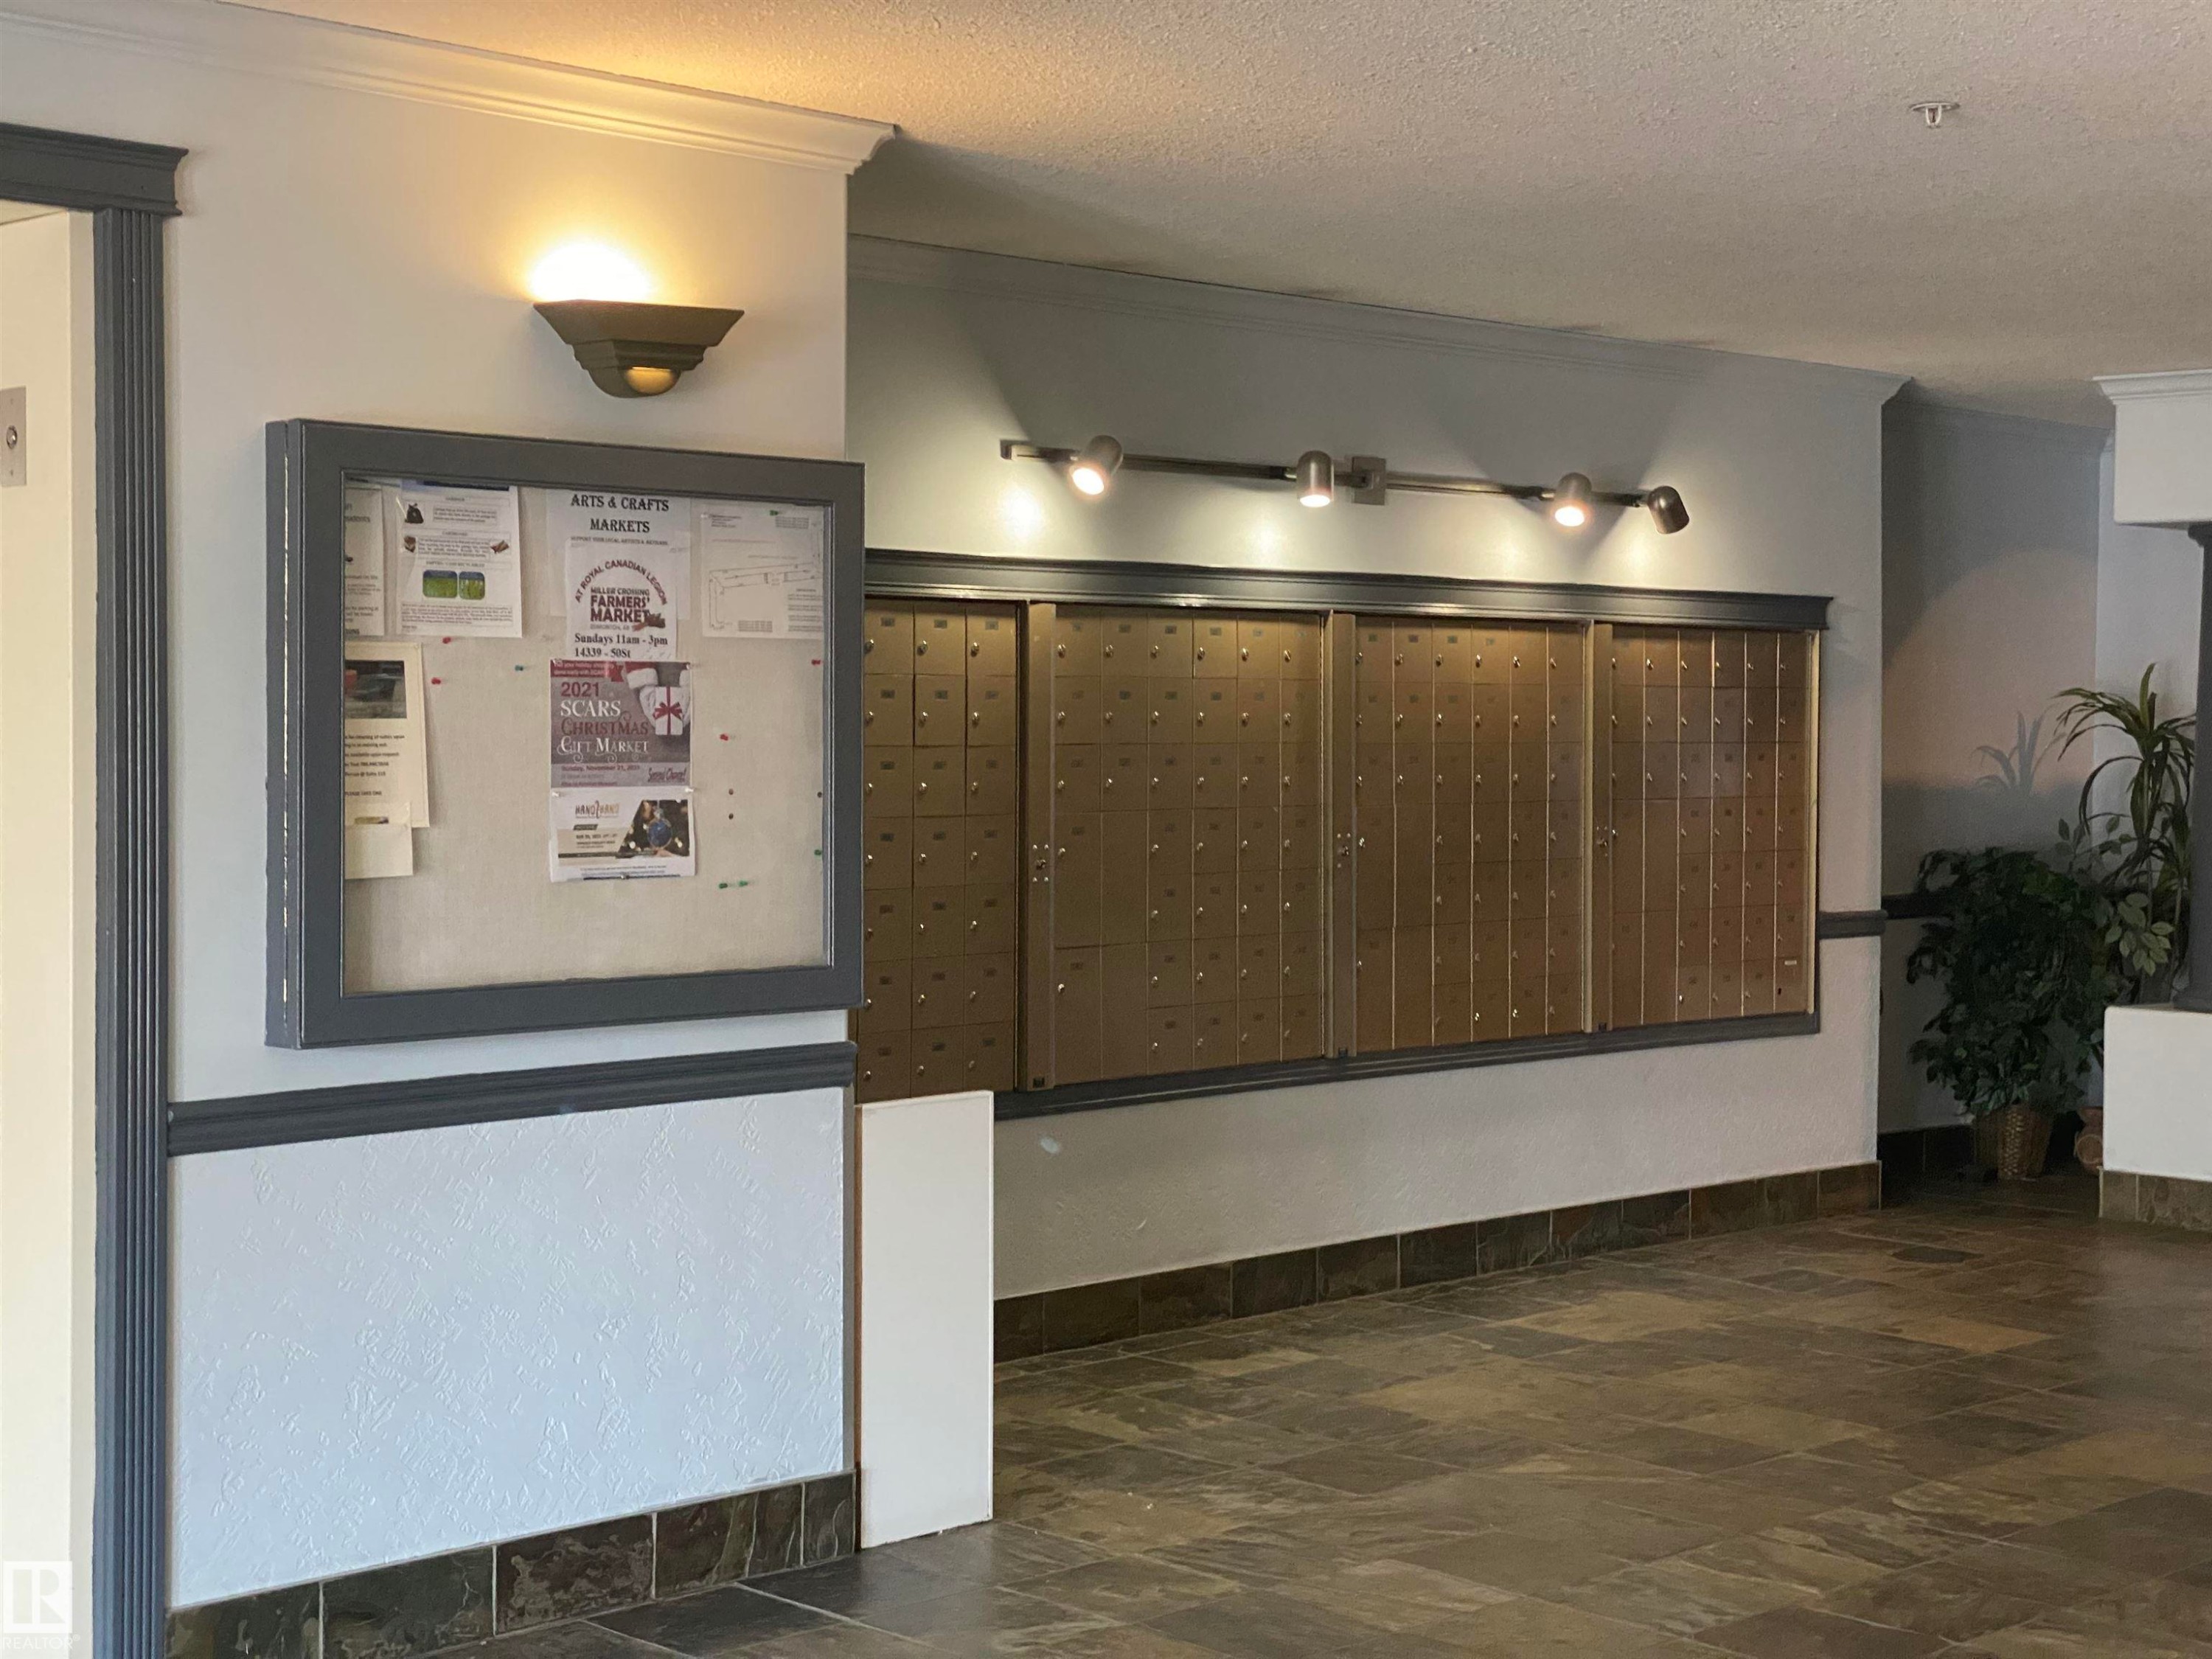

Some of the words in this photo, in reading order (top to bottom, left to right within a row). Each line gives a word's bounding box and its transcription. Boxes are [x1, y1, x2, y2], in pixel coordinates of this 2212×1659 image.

[571, 494, 605, 508] ARTS
[608, 495, 616, 509] &
[621, 497, 669, 512] CRAFTS
[590, 518, 650, 533] MARKETS
[575, 590, 583, 603] AT
[580, 566, 604, 590] ROYAL
[605, 560, 647, 576] CANADIAN
[646, 572, 667, 605] LEGION
[618, 588, 650, 596] CROSSING
[591, 595, 650, 608] FARMERS'
[591, 608, 650, 622] MARKET
[575, 633, 613, 646] Sundays
[616, 634, 640, 644] 11am
[648, 635, 668, 647] 3pm
[575, 647, 602, 657] 14339
[611, 648, 631, 658] 50St
[561, 682, 599, 698] 2021
[560, 700, 622, 717] SCARS
[561, 714, 649, 736] CHRISTMAS
[595, 737, 649, 759] MARKET
